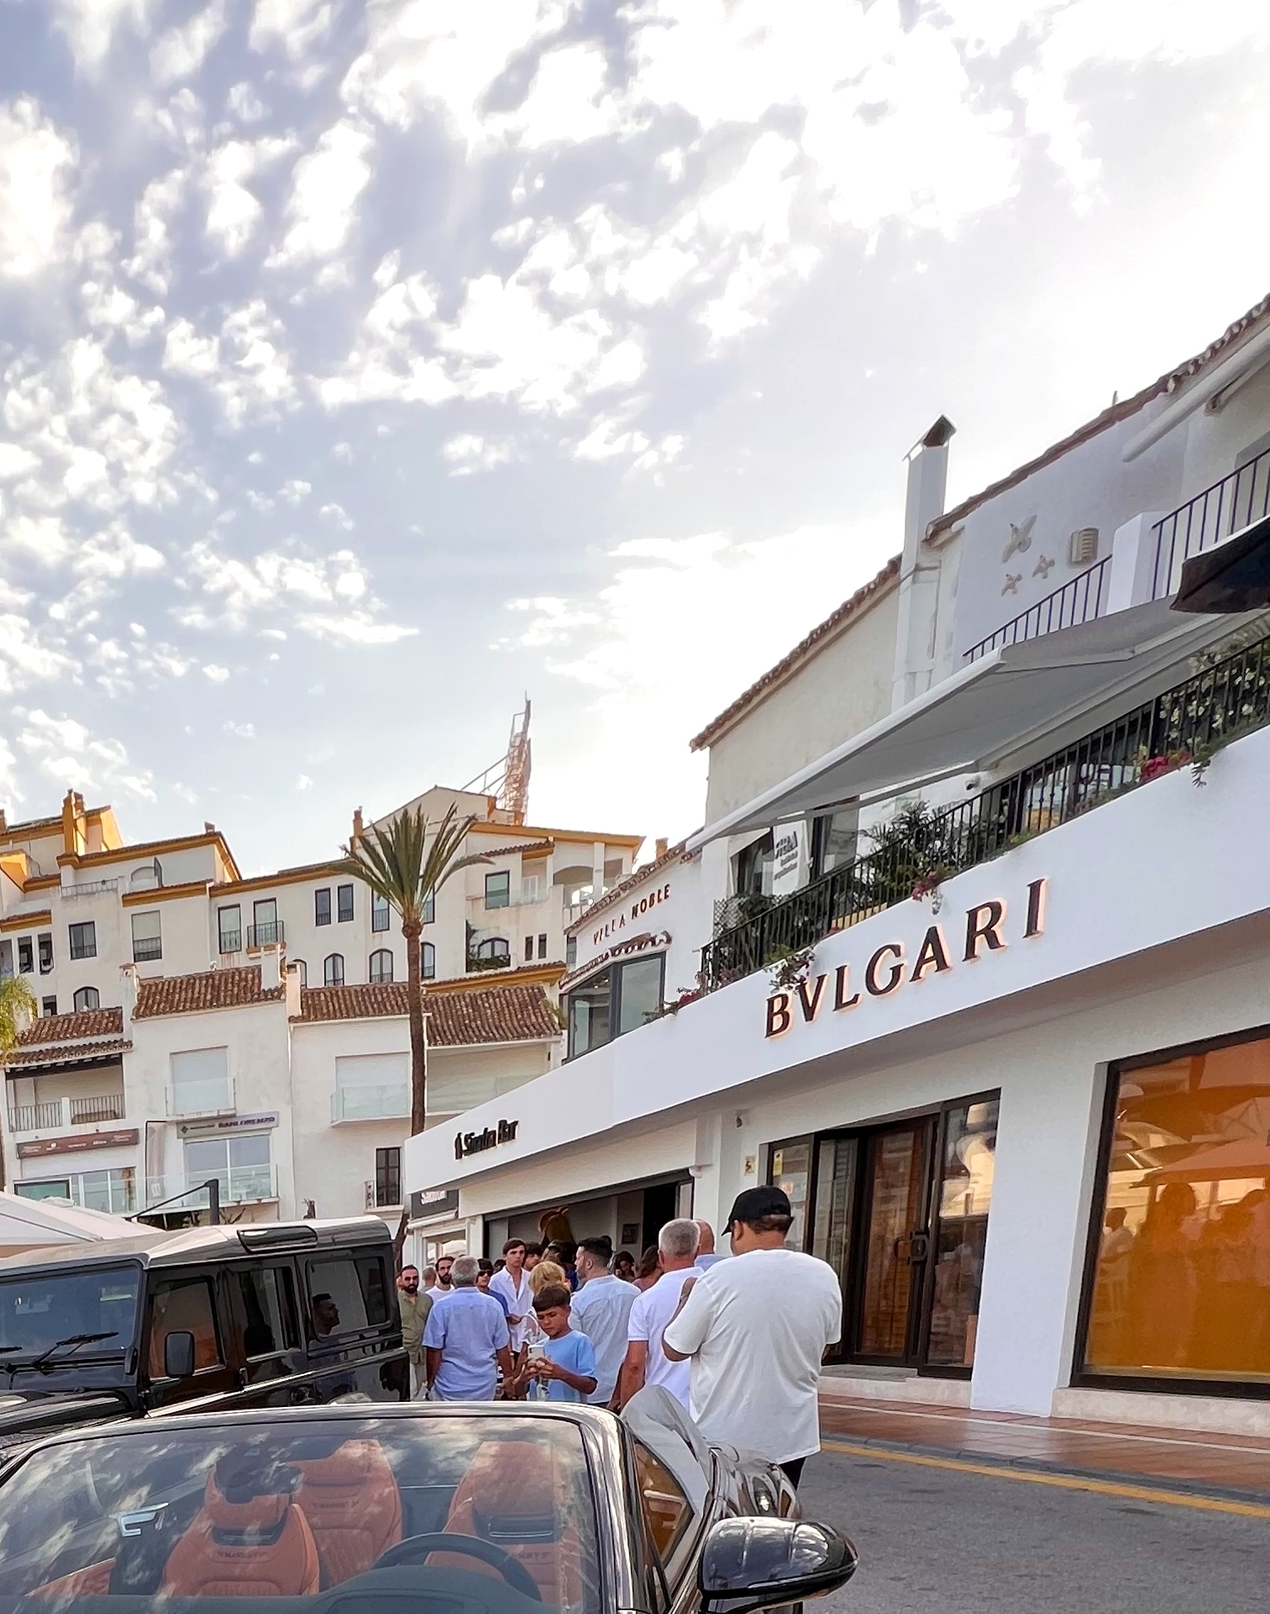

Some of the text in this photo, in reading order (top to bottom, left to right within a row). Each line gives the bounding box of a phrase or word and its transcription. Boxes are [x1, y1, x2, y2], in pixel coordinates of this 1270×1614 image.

[593, 884, 671, 946] VILLA NOBLE
[764, 878, 1046, 1039] BVLGARI
[498, 1119, 519, 1145] Bar
